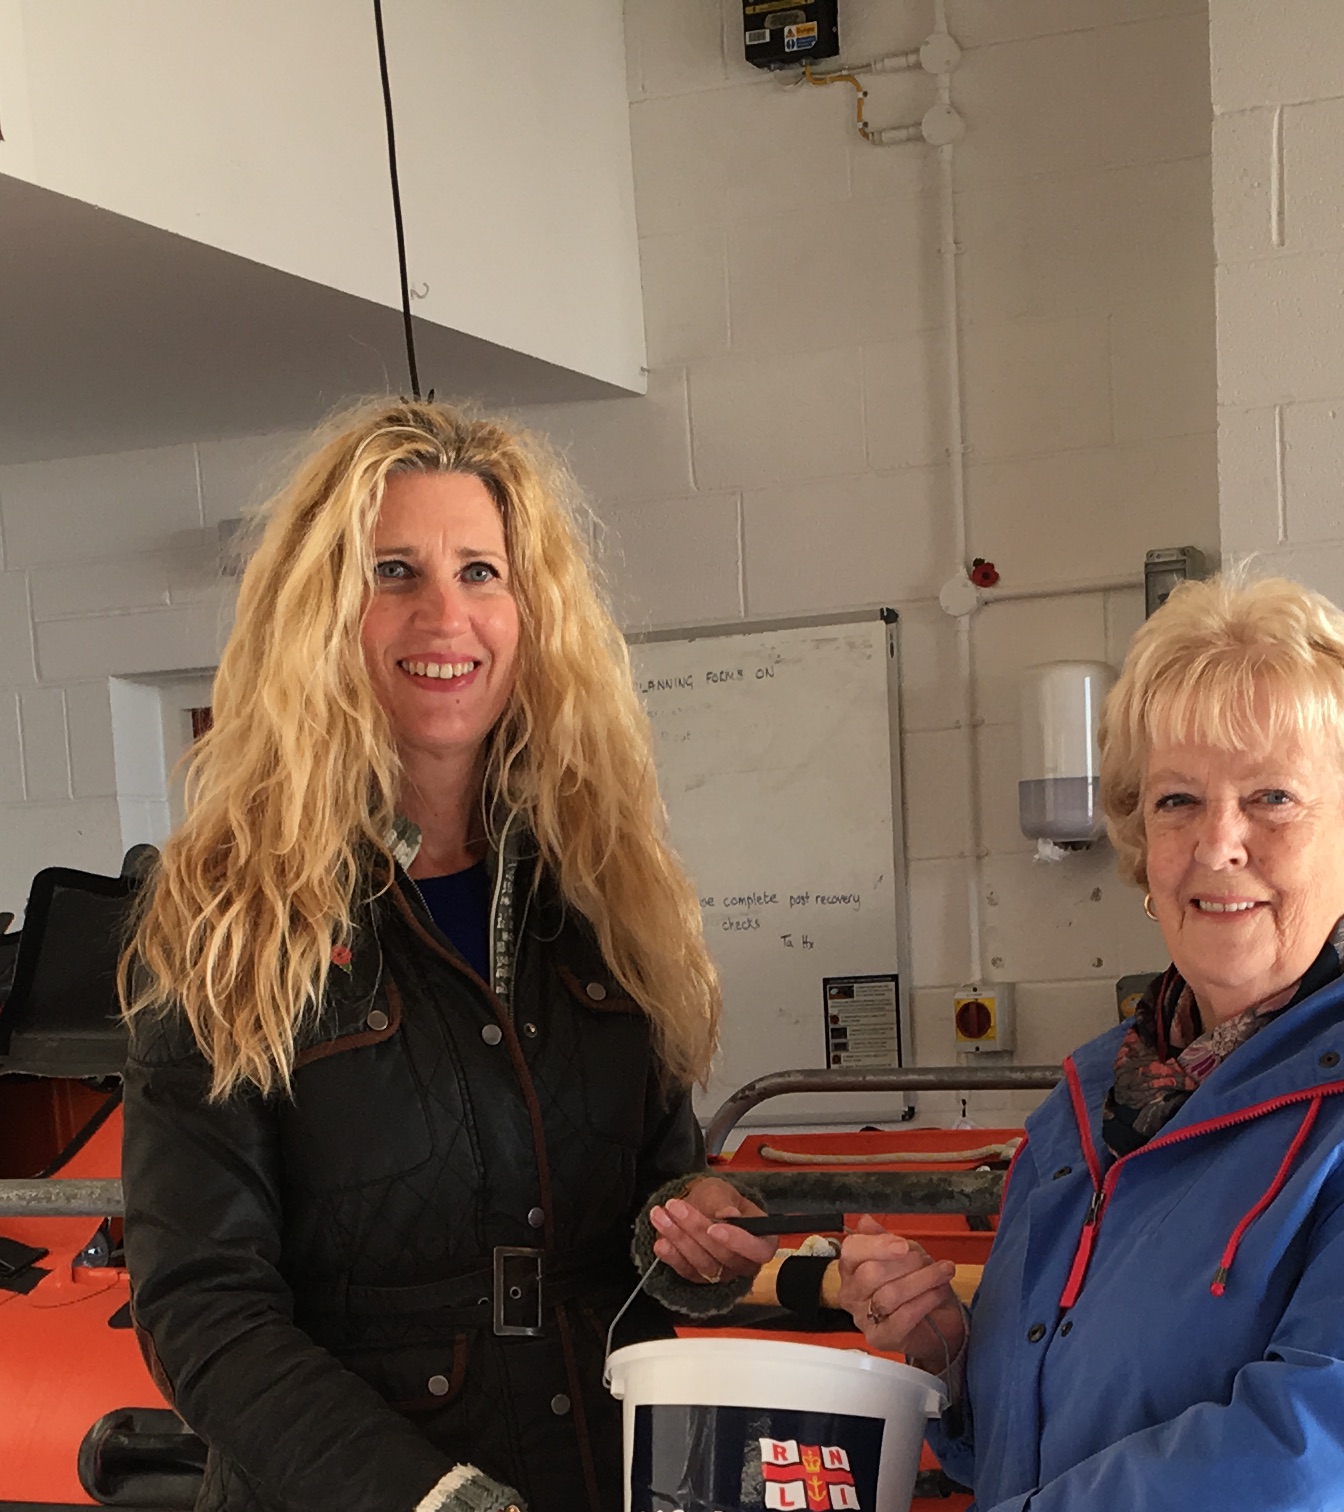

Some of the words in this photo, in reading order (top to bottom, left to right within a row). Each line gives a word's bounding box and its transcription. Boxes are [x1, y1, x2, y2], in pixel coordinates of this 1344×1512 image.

[755, 665, 775, 680] ON
[722, 891, 779, 909] complete
[789, 891, 810, 908] post
[815, 893, 861, 912] recovery
[721, 917, 761, 931] checks
